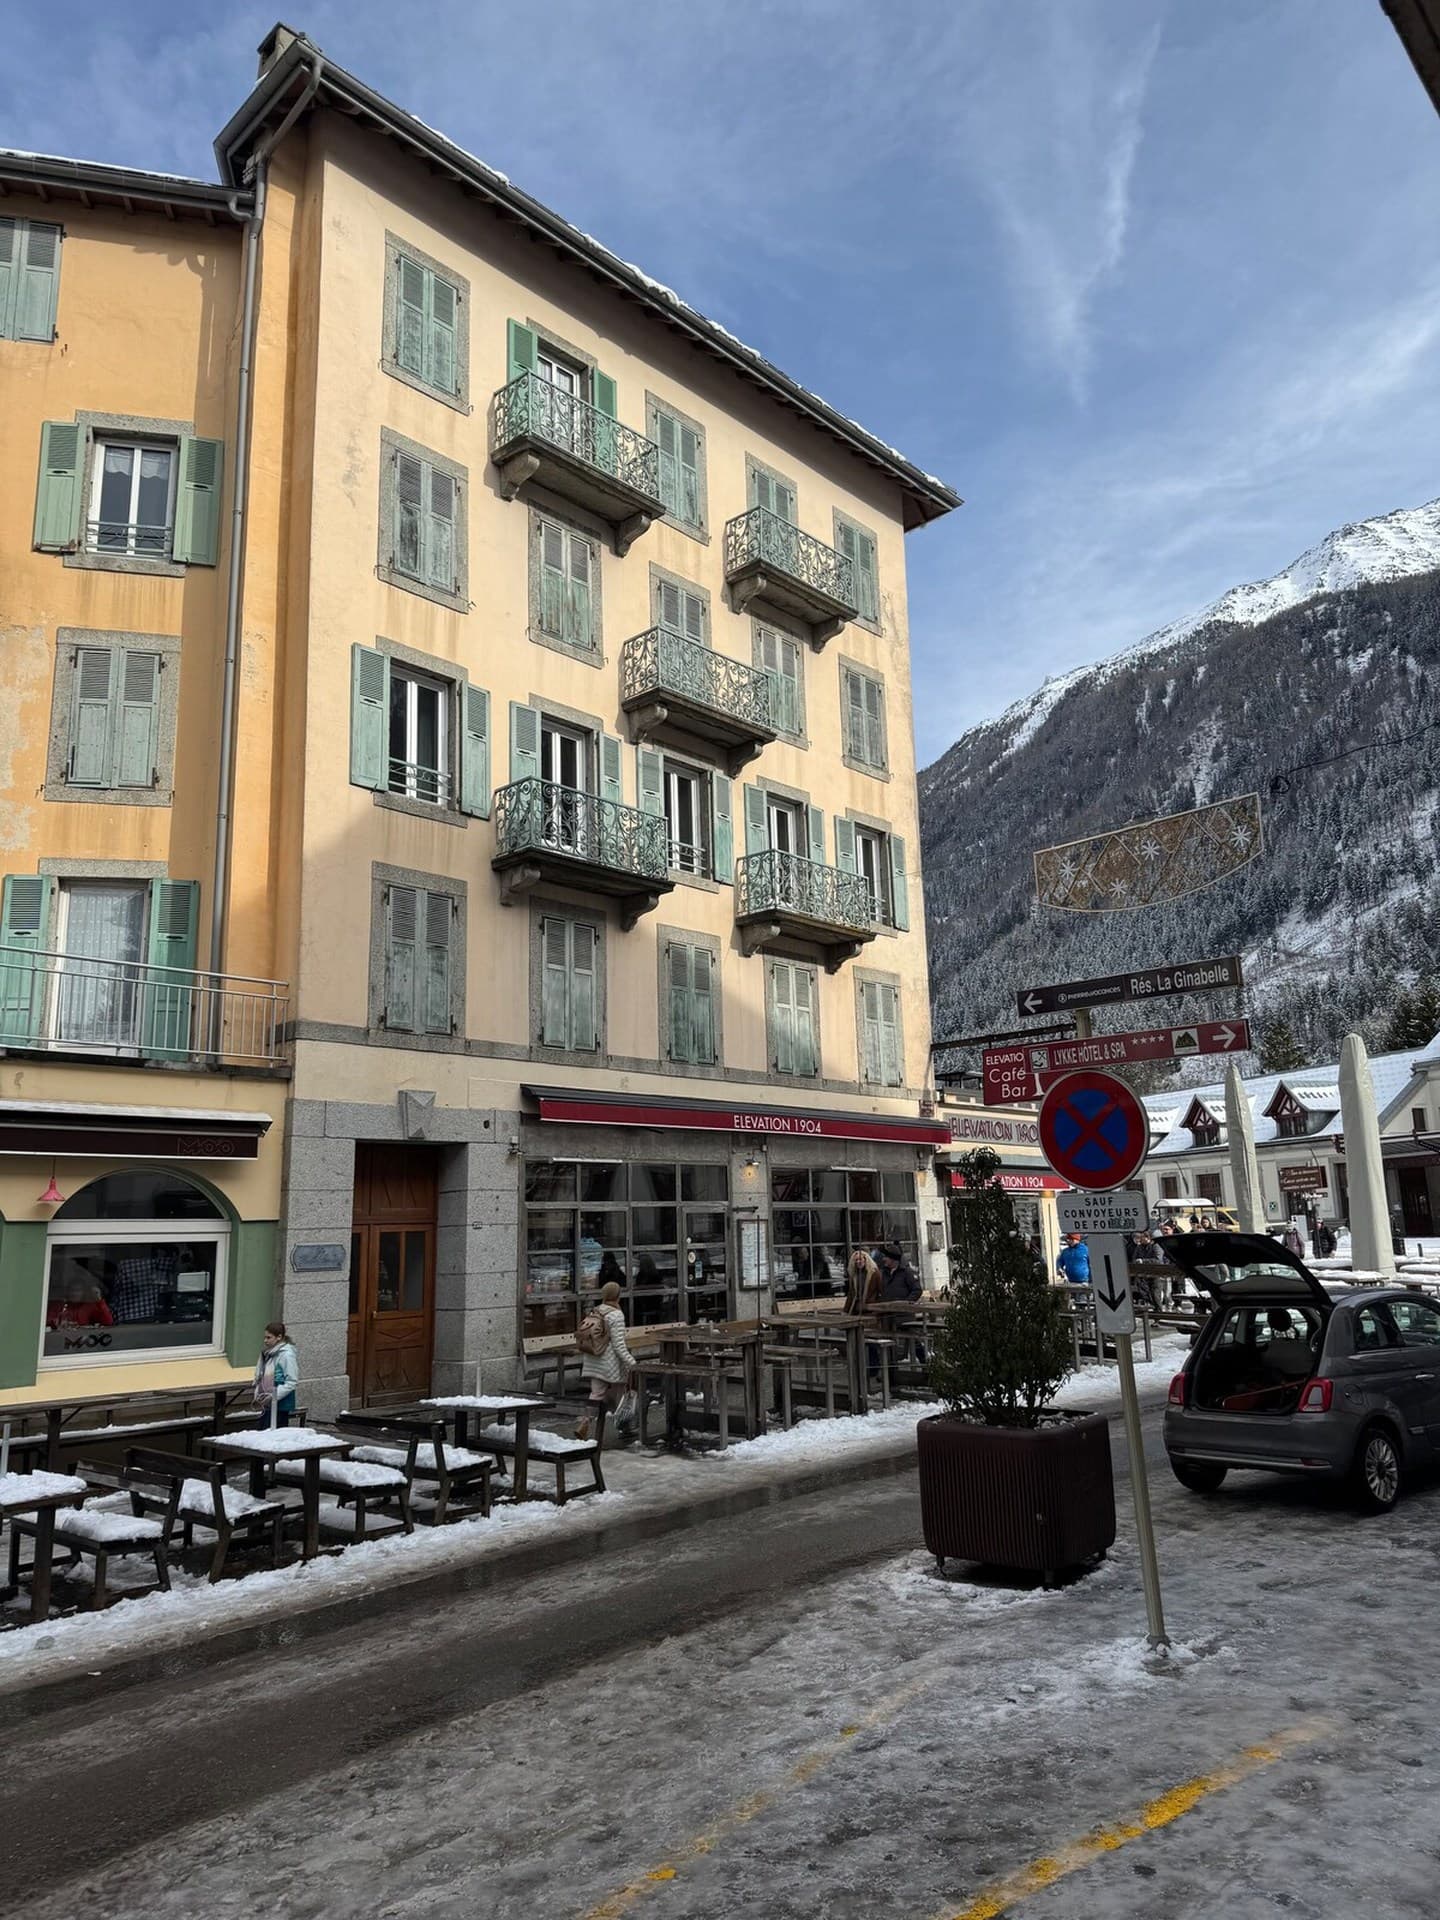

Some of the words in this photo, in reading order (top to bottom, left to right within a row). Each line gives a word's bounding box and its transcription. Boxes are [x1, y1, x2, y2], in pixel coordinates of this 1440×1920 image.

[1130, 976, 1156, 995] Rés.
[1157, 974, 1172, 991] La
[1173, 964, 1230, 989] Ginabelle
[985, 1051, 1025, 1066] ELEVATIO
[1054, 1047, 1078, 1066] LYKKE
[1078, 1041, 1103, 1063] HÔTEL
[1104, 1043, 1111, 1060] &
[1110, 1041, 1127, 1060] SPA
[989, 1067, 1026, 1084] Café
[1001, 1084, 1028, 1098] Bar
[733, 1114, 791, 1131] ELEVATION
[794, 1119, 822, 1133] 1904
[949, 1117, 1013, 1141] ELEVATION
[1015, 1123, 1039, 1143] 190
[1025, 1176, 1044, 1188] 1904
[1084, 1196, 1114, 1207] SAUF
[1063, 1207, 1139, 1219] CONVOYEURS
[1074, 1220, 1088, 1230] DE
